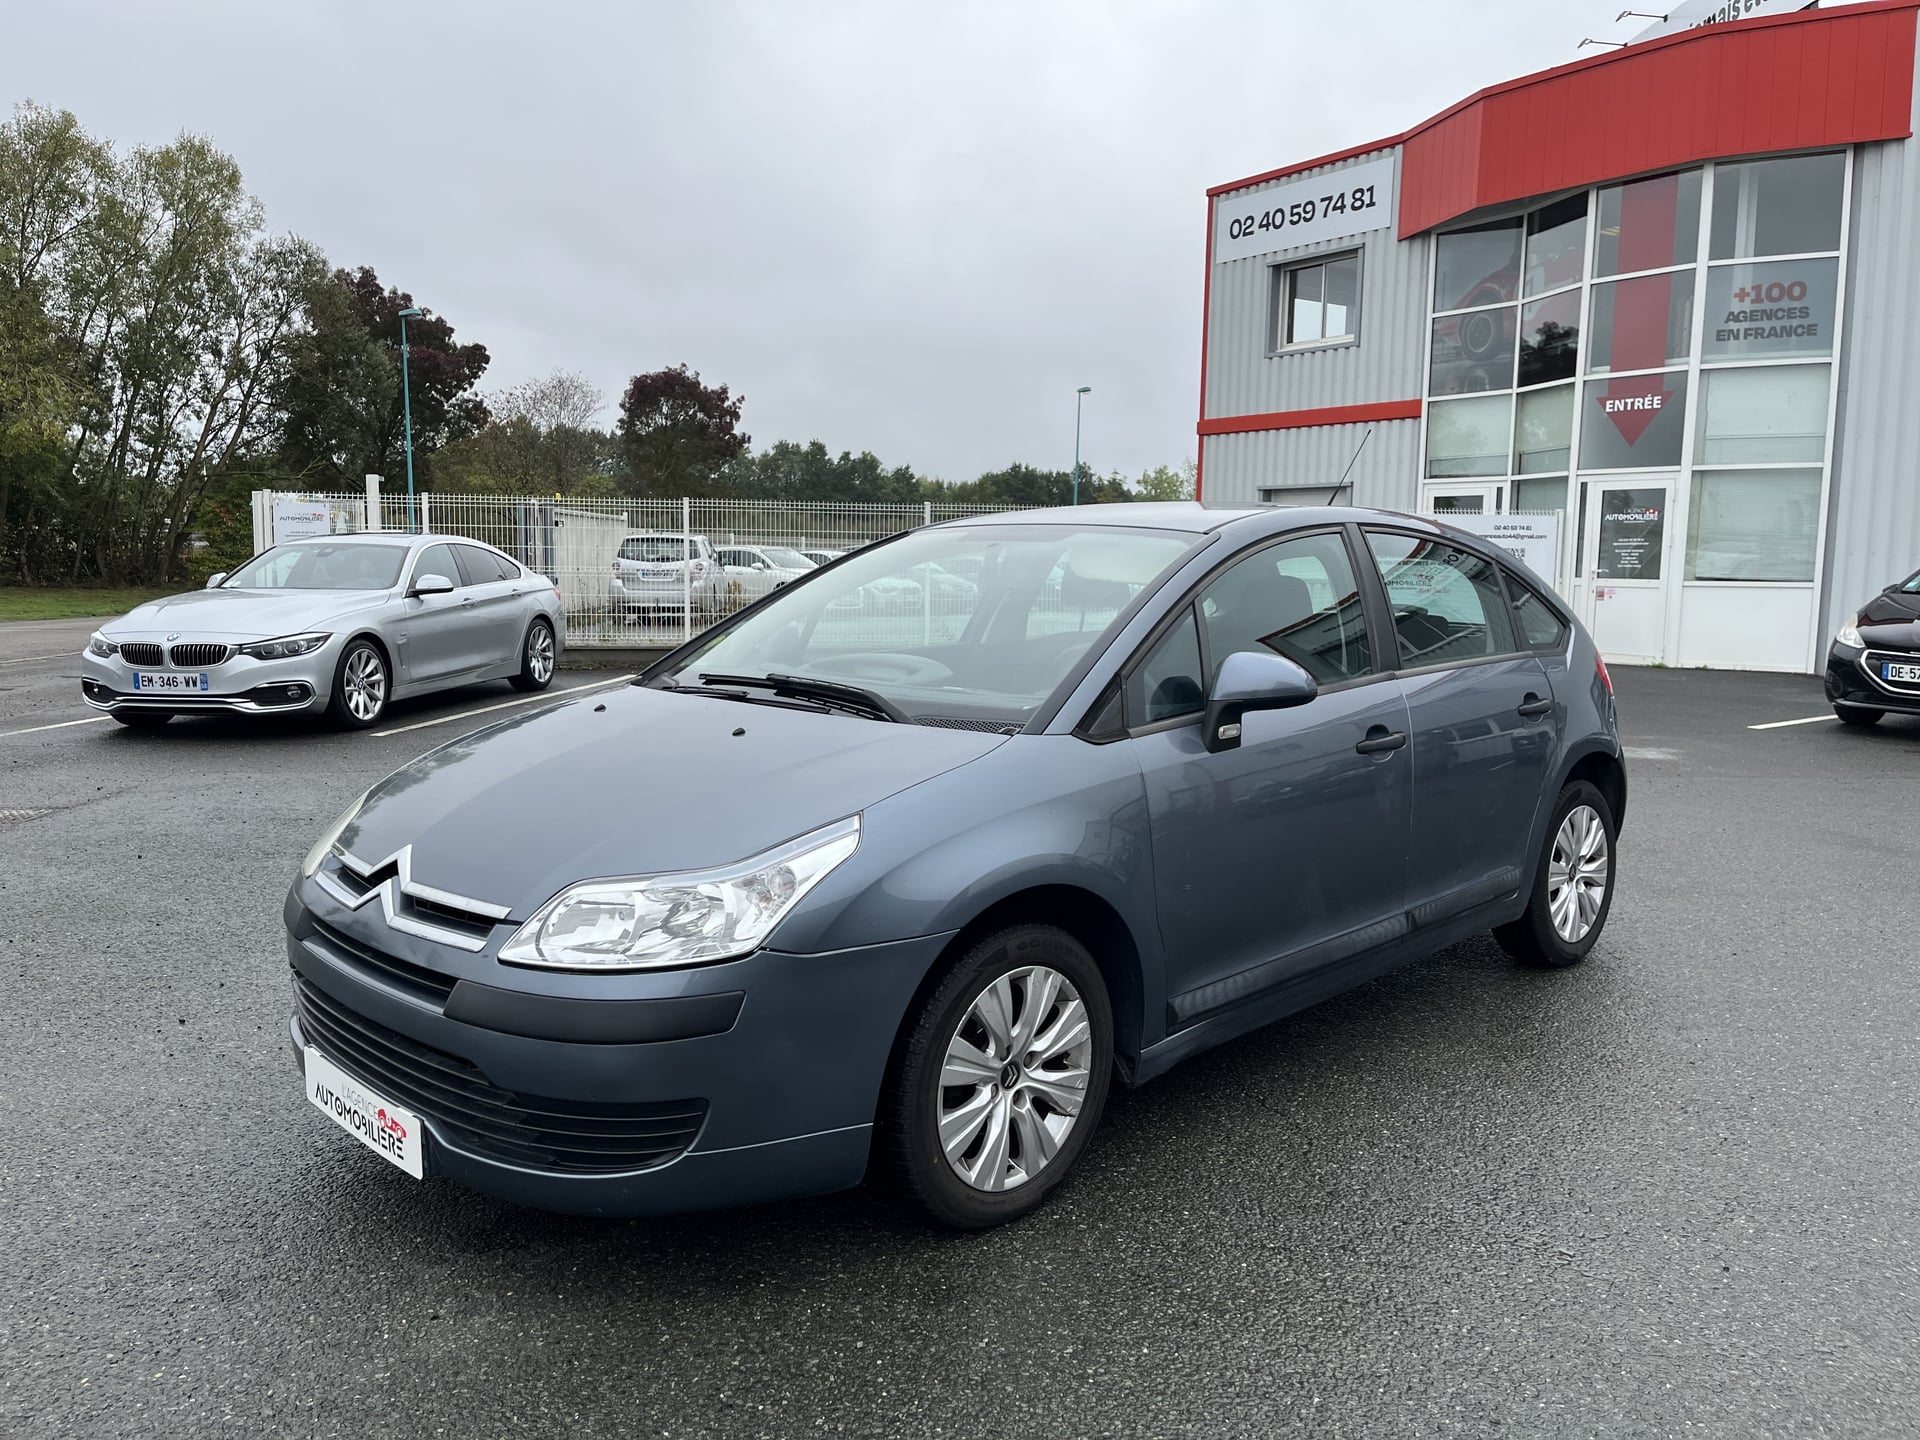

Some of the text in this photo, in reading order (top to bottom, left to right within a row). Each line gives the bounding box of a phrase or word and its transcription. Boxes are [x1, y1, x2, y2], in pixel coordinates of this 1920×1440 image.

[1229, 184, 1376, 239] 02 40 59 74 81
[1733, 281, 1808, 304] +100
[1724, 306, 1810, 324] AGENCES
[1715, 323, 1818, 342] EN FRANCE
[1605, 394, 1662, 412] ENTRÉE
[140, 675, 198, 688] EM-346-WW
[342, 1084, 379, 1120] L'AGENCE
